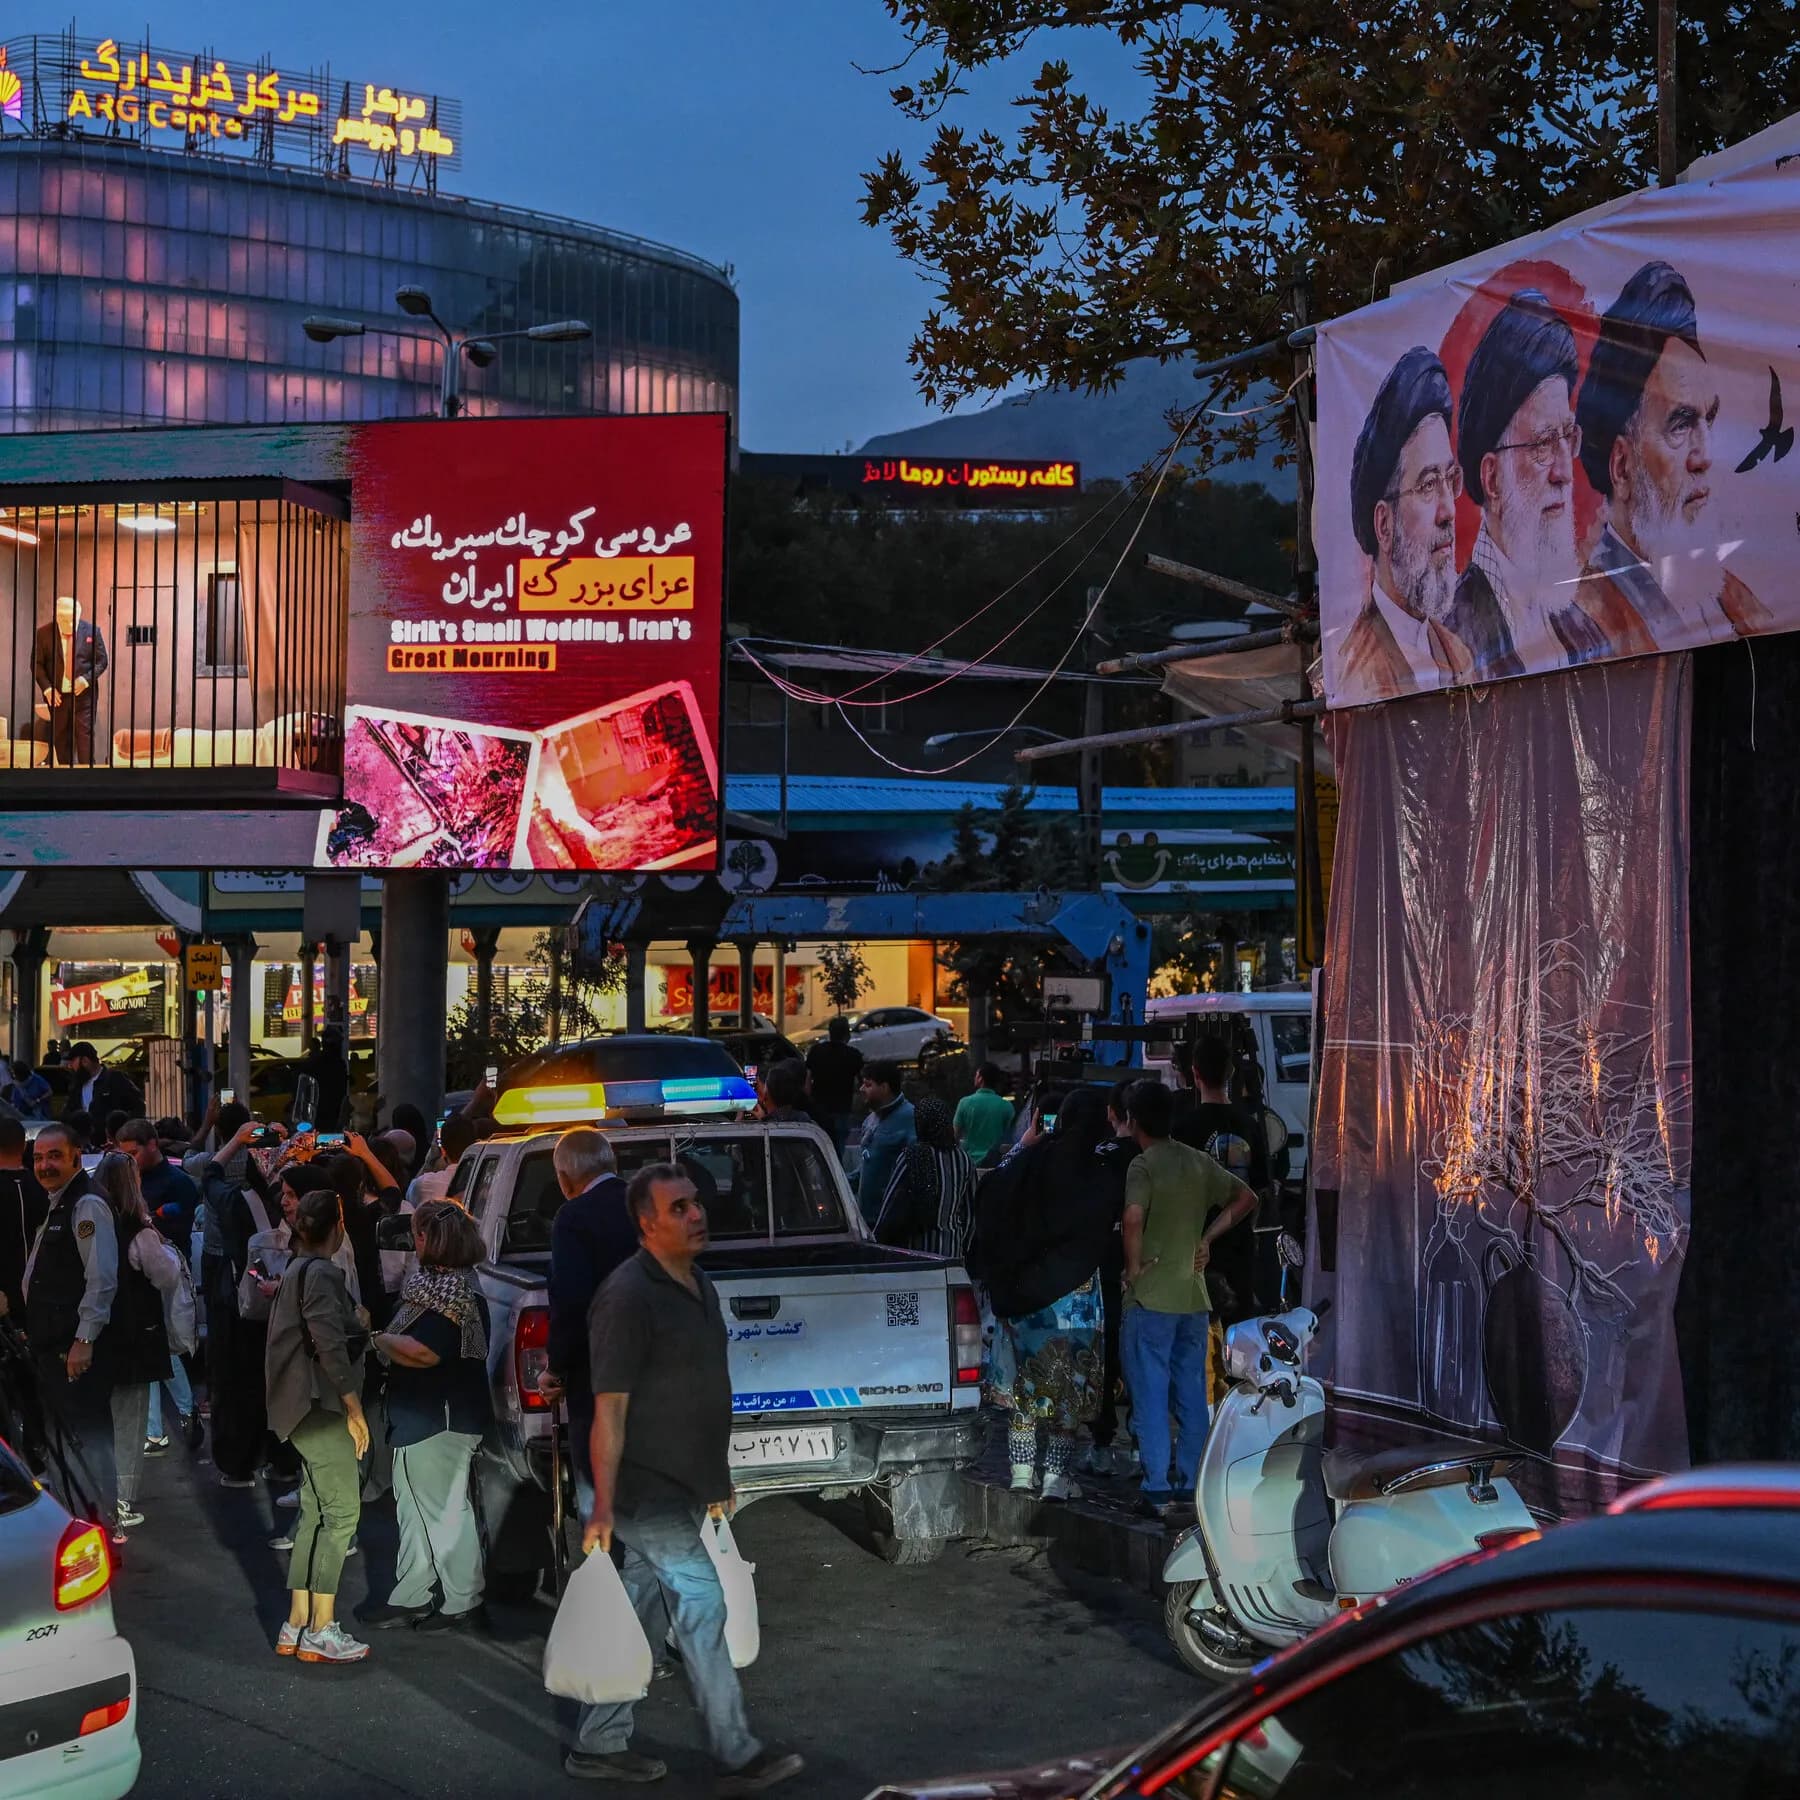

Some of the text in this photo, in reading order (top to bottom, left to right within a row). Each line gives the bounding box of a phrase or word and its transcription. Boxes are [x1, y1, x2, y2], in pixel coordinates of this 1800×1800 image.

[80, 39, 320, 122] مرکز خرید ارگ
[68, 89, 254, 141] ARG Center
[362, 84, 427, 122] مرکز
[332, 117, 454, 156] طلا و جواهر
[900, 460, 944, 486] روما
[947, 463, 1027, 487] رستوران
[1030, 464, 1074, 486] کافه
[595, 522, 692, 557] عروسی
[442, 556, 690, 611] عزای بزرگ ایران
[391, 617, 692, 643] Sirik's Small Wedding, Iran's
[391, 648, 549, 669] Great Mourning
[766, 1321, 803, 1335] گشت
[743, 1394, 771, 1408] مراقب
[773, 1398, 787, 1407] من
